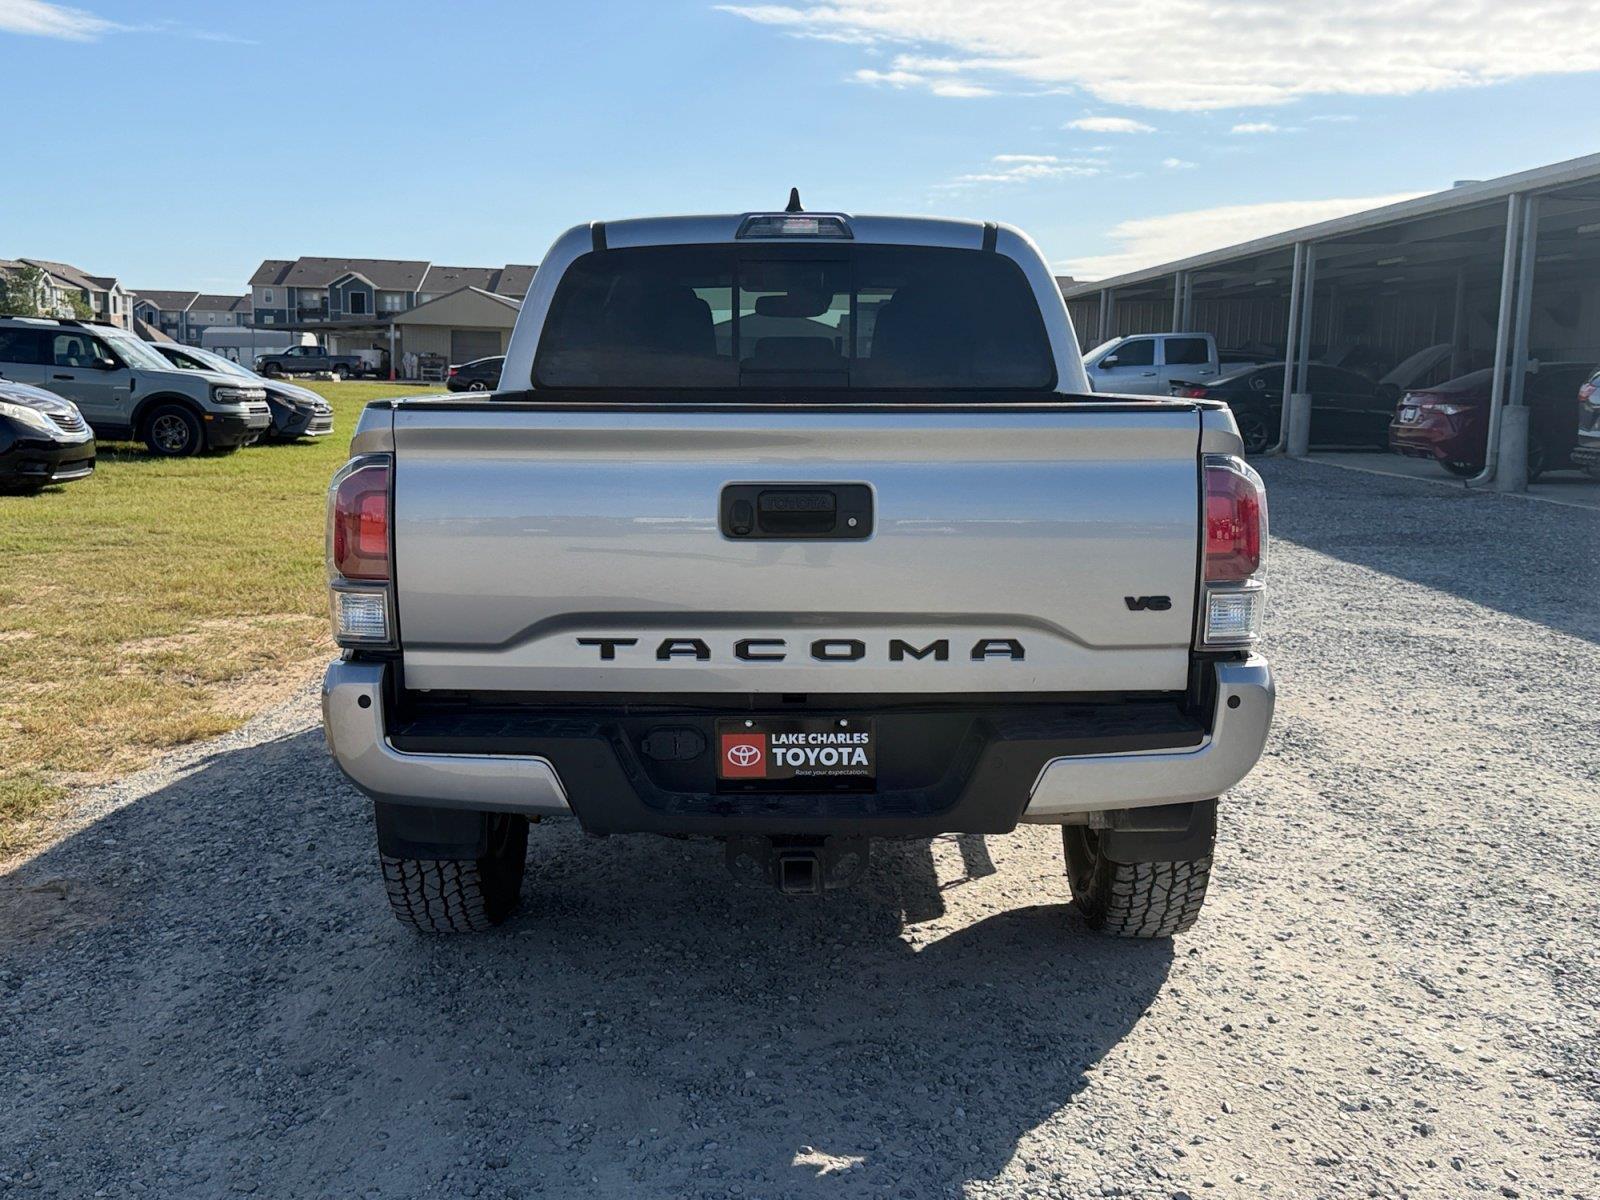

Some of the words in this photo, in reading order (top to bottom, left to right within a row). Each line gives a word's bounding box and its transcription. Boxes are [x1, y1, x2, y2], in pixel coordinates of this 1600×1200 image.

[1124, 595, 1172, 611] V6
[576, 638, 1025, 661] TACOMA
[771, 733, 806, 745] LAKE
[808, 732, 869, 744] CHARLES
[772, 747, 869, 766] TOYOTA
[812, 769, 827, 777] your
